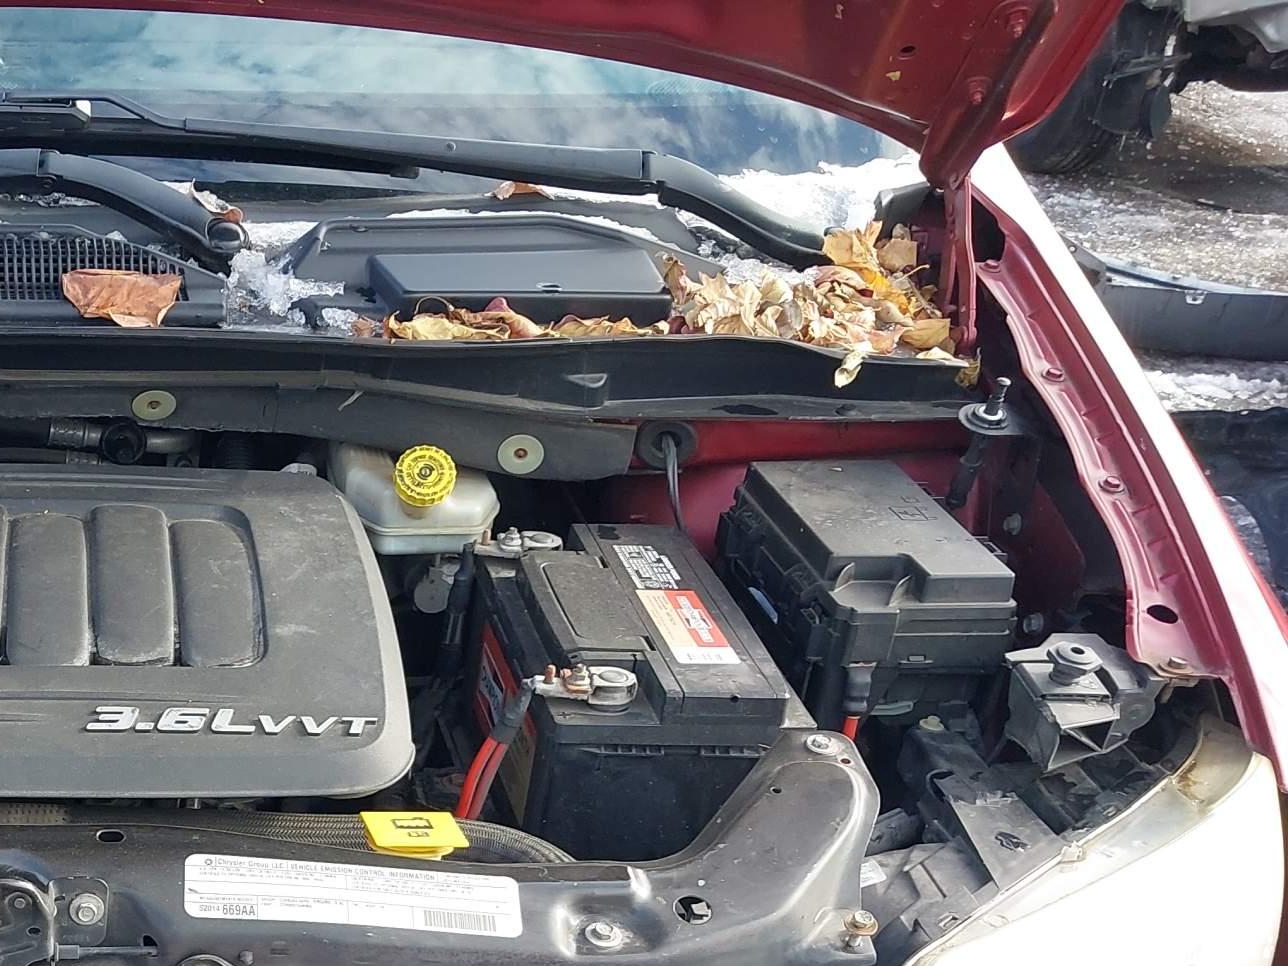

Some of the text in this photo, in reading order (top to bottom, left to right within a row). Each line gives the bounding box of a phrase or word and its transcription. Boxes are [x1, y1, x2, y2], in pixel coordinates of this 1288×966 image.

[217, 857, 246, 867] Chrysler
[248, 860, 269, 869] Group
[290, 862, 318, 871] VEHICLE
[320, 865, 353, 874] EMISSION
[355, 868, 386, 877] CONTROL
[388, 871, 436, 881] INFORMATION
[222, 903, 256, 916] 669AA
